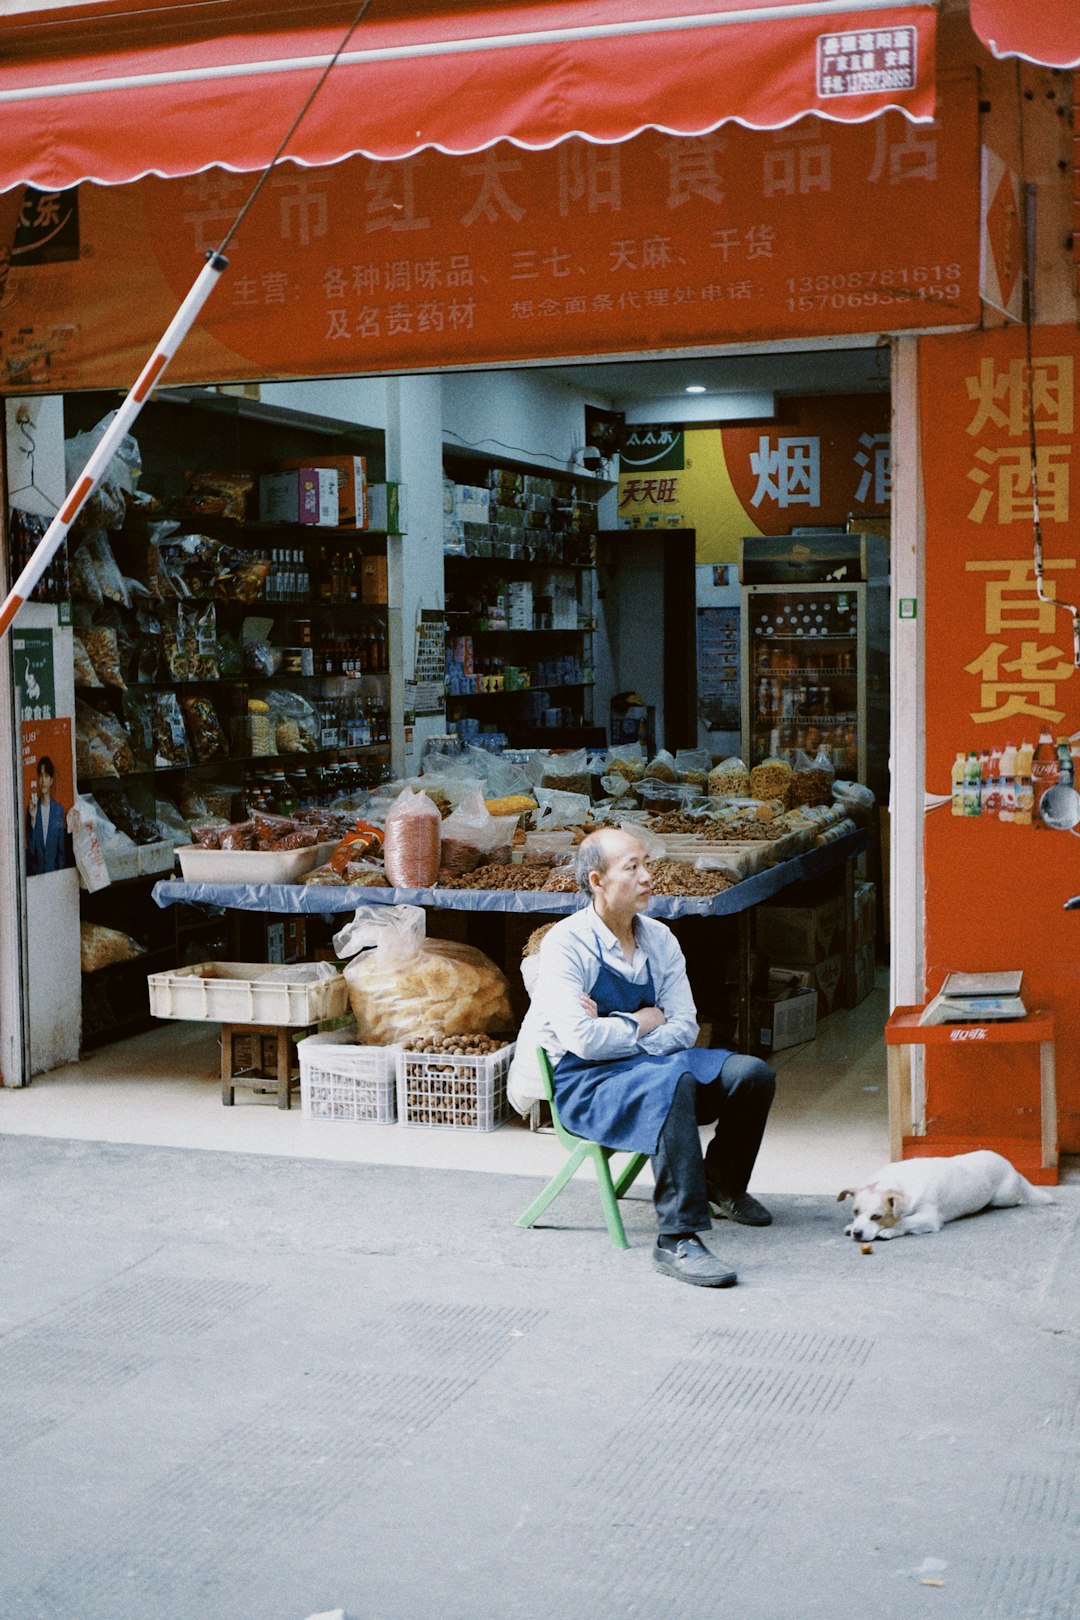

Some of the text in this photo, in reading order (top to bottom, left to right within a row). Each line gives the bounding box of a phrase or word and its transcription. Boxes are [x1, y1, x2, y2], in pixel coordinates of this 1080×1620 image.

[183, 116, 938, 250] 芒市红太阳食品店
[710, 224, 778, 263] 干货
[786, 263, 961, 293] 13808781618
[325, 297, 477, 340] 及名贵药材
[619, 478, 677, 508] 天天旺
[963, 355, 1077, 724] 烟酒百货
